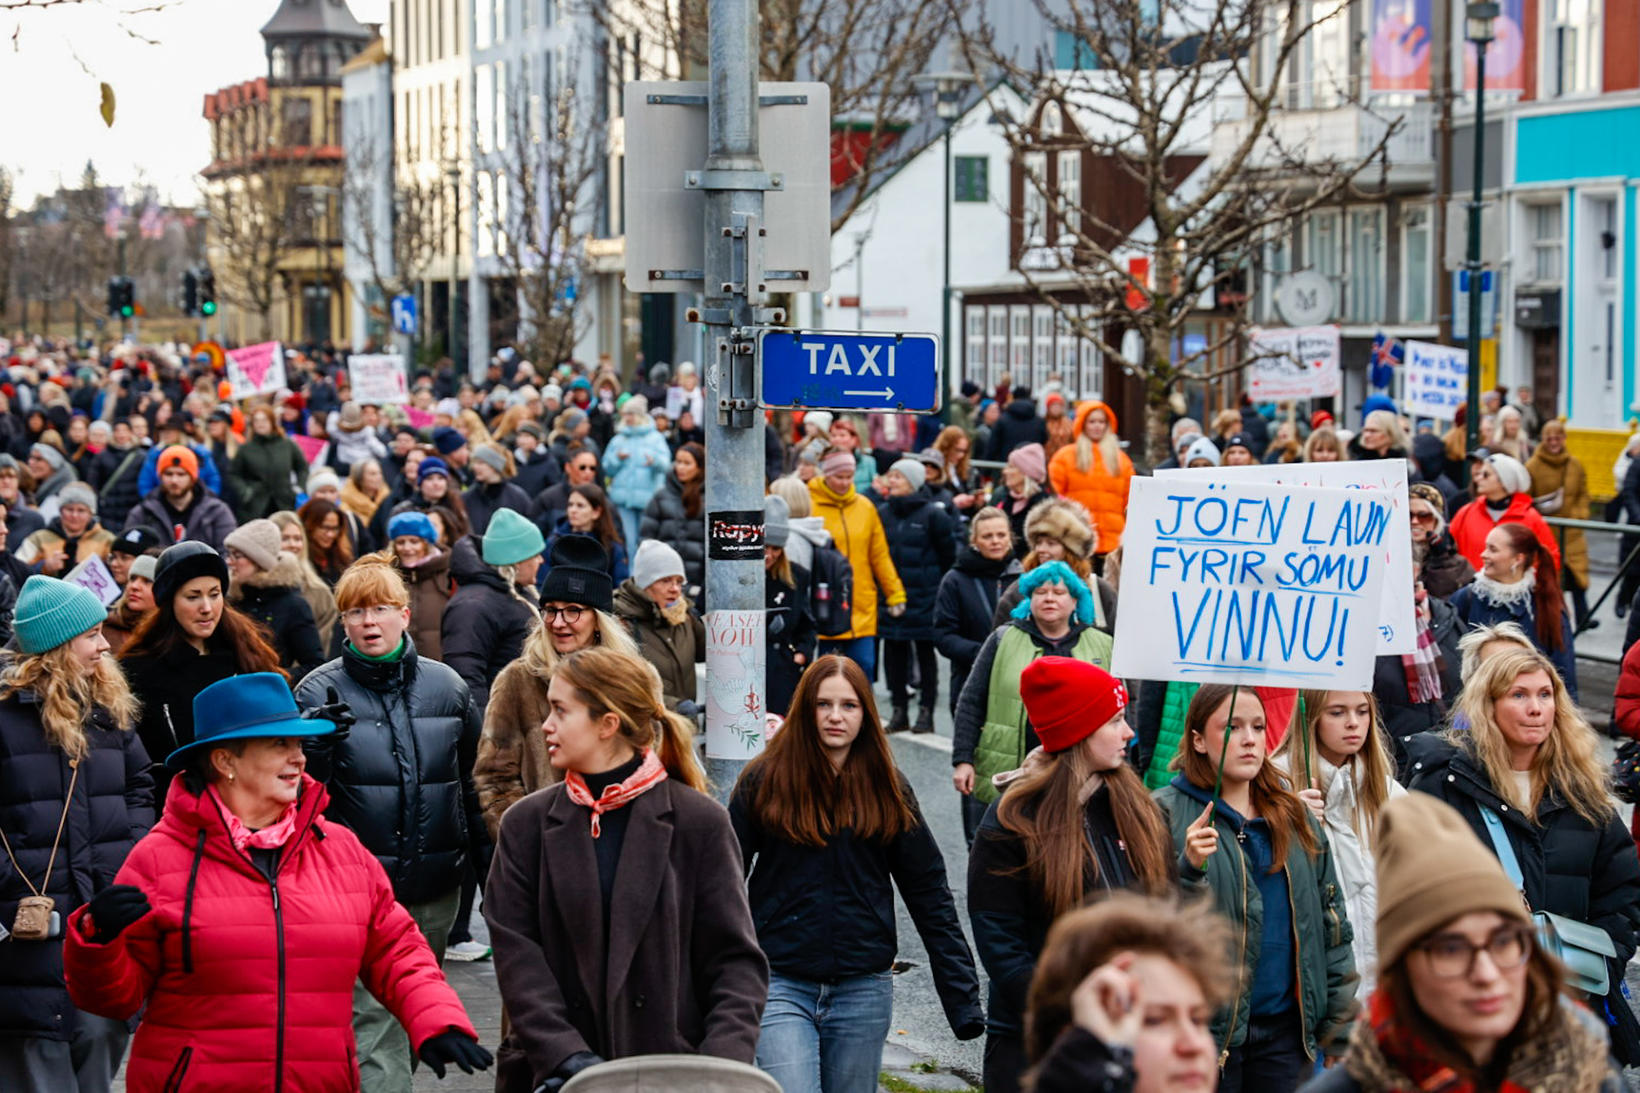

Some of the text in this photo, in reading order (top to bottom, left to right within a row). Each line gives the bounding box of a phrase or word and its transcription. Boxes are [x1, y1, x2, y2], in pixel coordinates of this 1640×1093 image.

[802, 343, 896, 377] TAXI
[1155, 483, 1392, 546] JÖFN LAUN
[1149, 546, 1370, 592] FYRIR SÖMU
[1172, 588, 1350, 667] VINNU!
